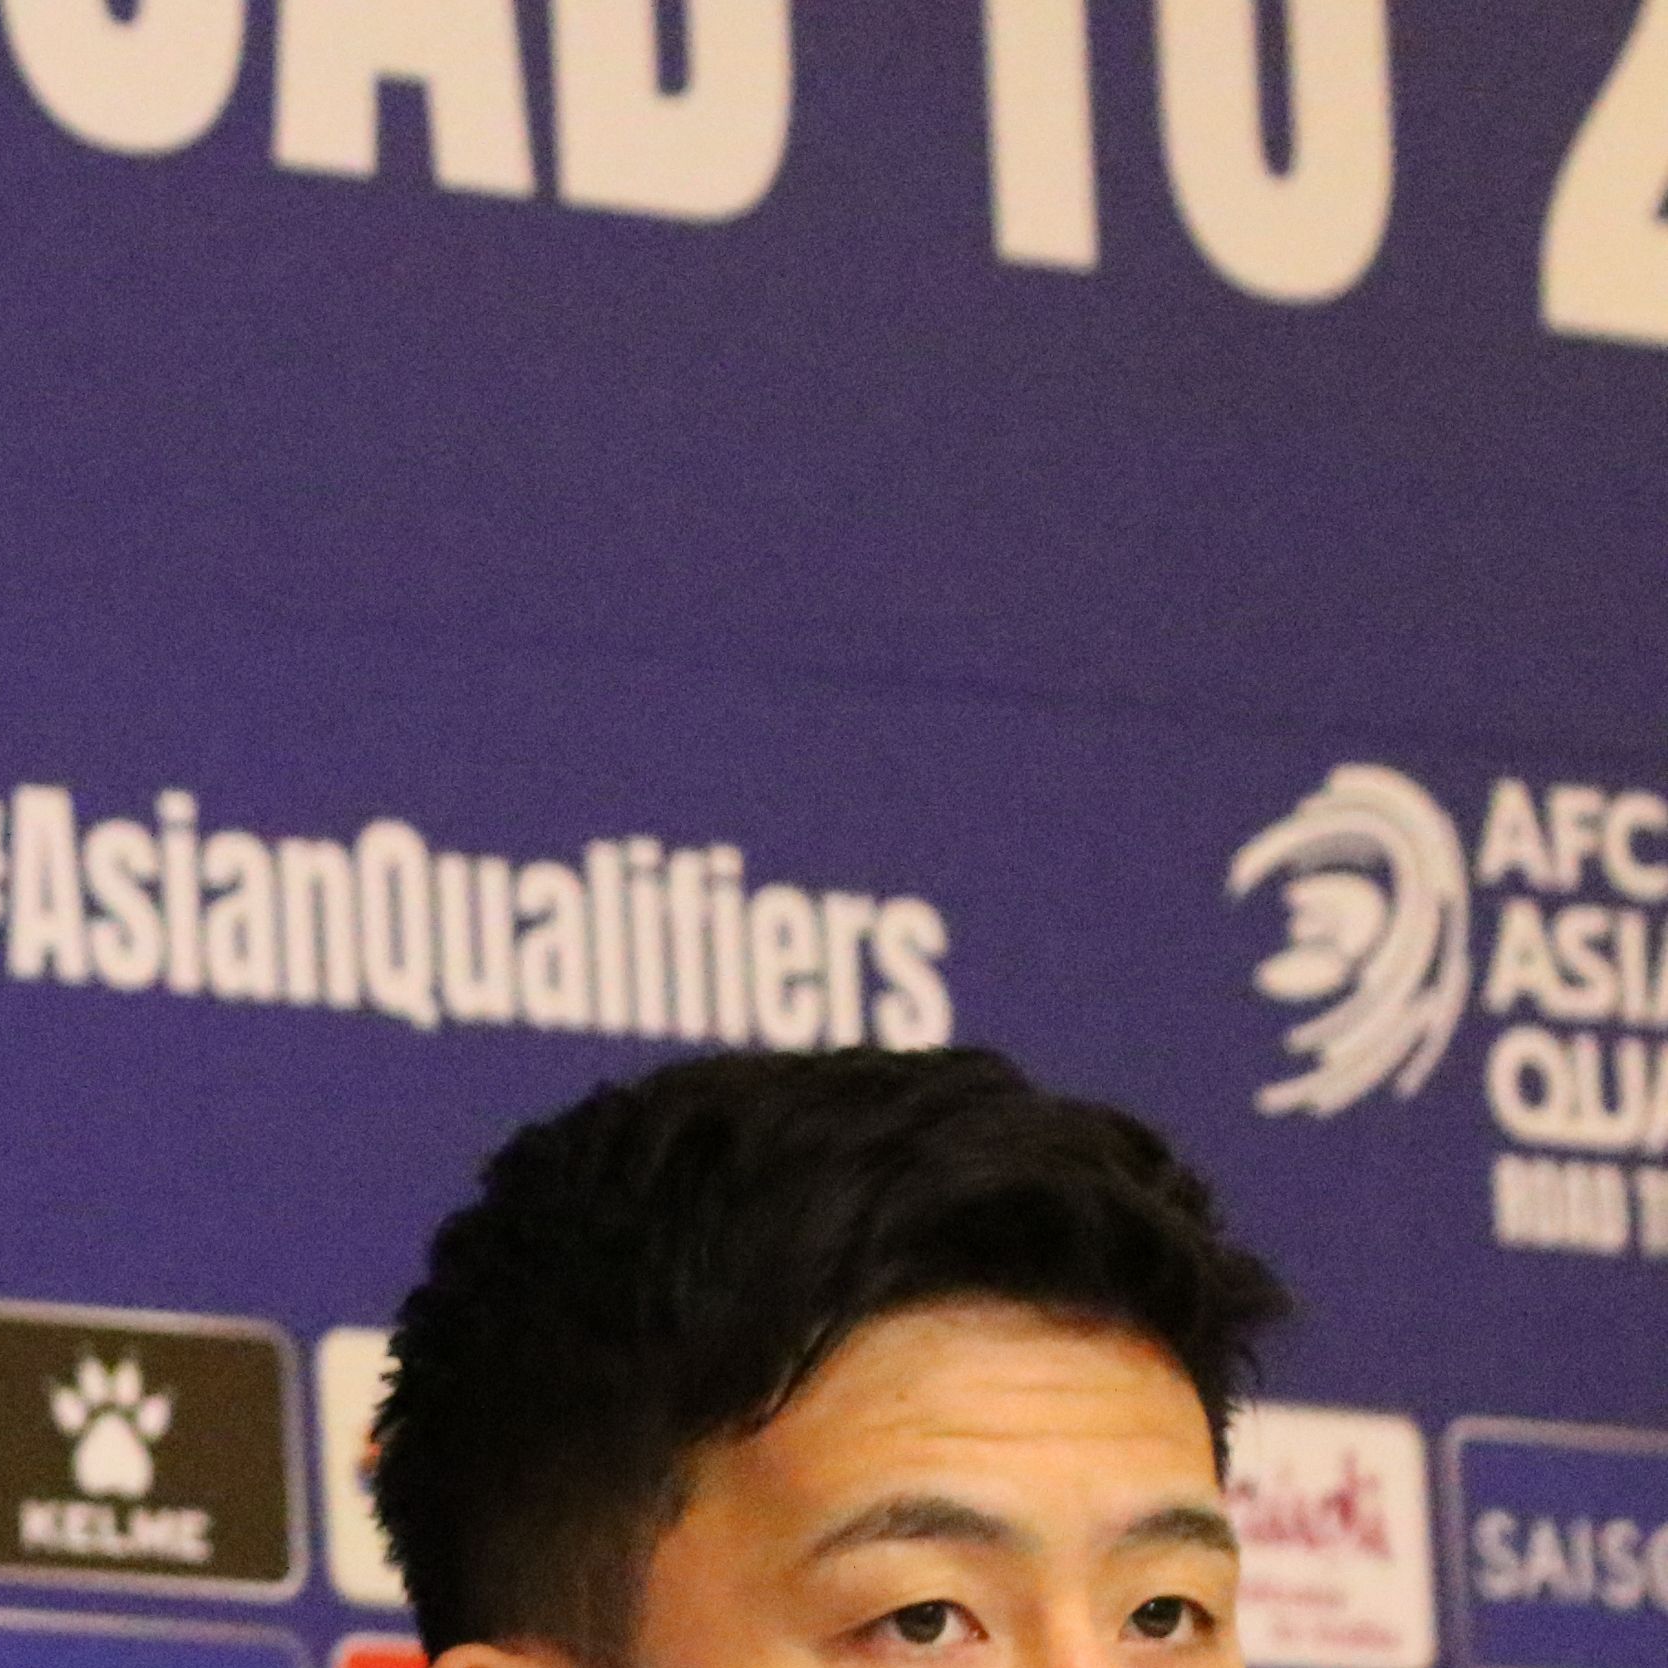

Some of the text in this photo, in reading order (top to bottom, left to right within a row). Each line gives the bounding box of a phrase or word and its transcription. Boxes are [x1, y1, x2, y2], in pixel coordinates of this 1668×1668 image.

[1476, 776, 1668, 902] AFC
[1482, 899, 1668, 1026] ASI
[18, 1497, 212, 1561] KELME
